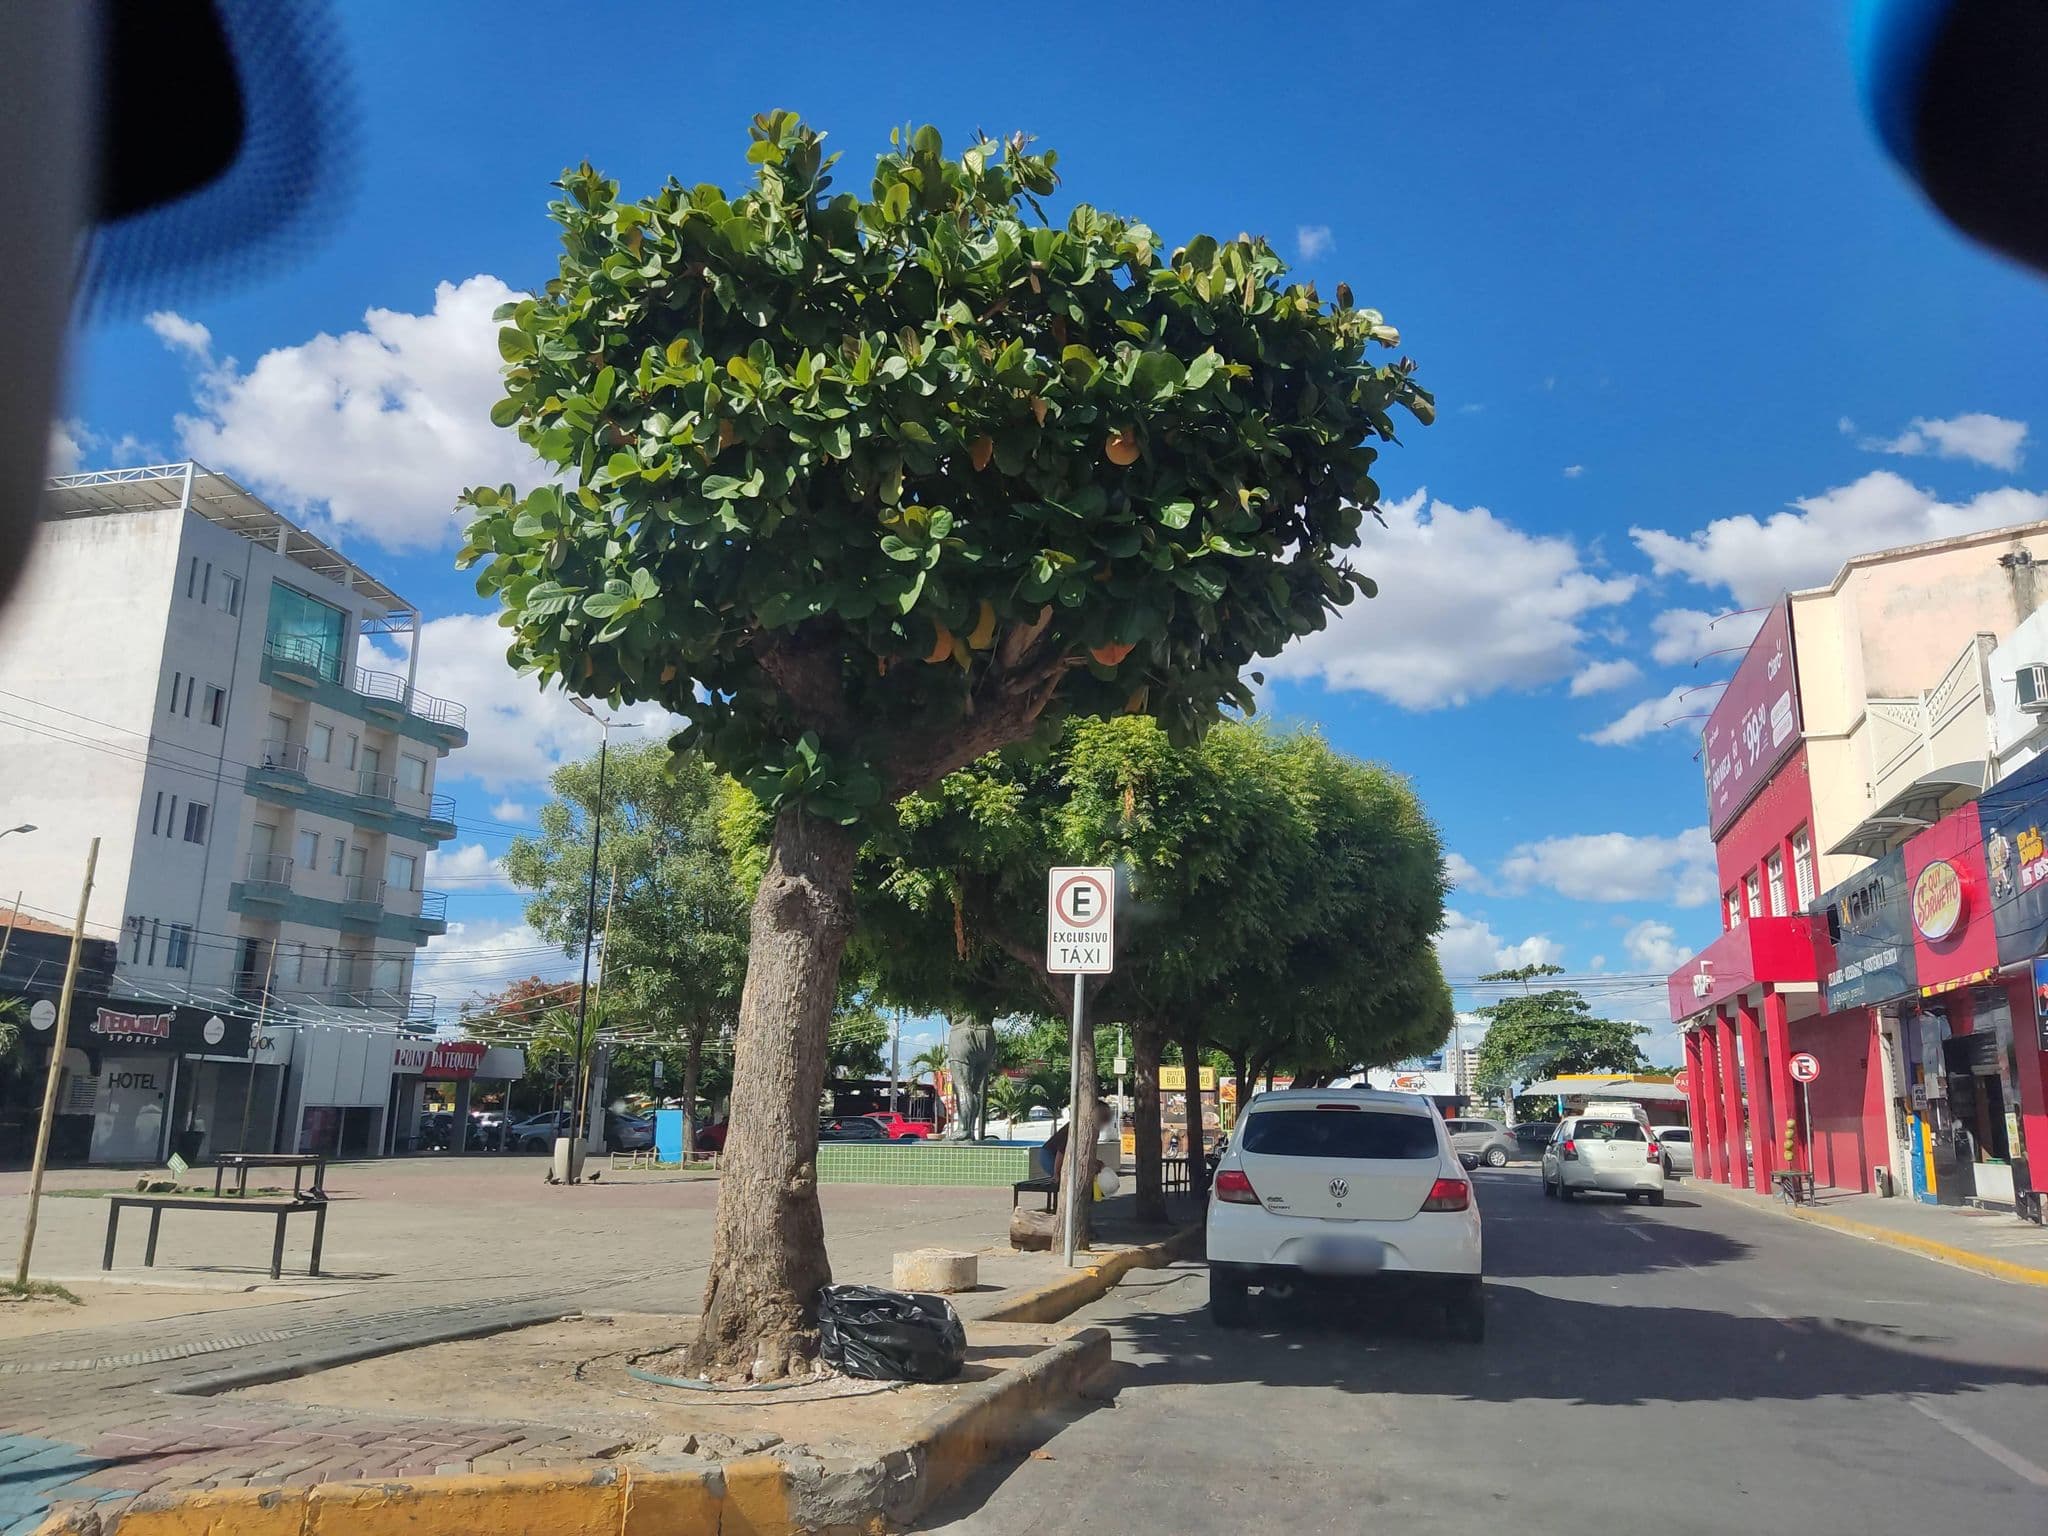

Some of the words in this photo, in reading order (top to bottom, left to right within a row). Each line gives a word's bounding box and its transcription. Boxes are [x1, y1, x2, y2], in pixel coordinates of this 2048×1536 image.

[1072, 887, 1091, 916] E
[1053, 932, 1108, 943] EXCLUSIVO
[1060, 945, 1100, 964] TÁXI
[97, 1008, 170, 1038] TEQUILA
[109, 1034, 158, 1045] SPORTS
[431, 1050, 443, 1068] DA
[445, 1051, 480, 1071] TEQUILA
[109, 1072, 158, 1089] HOTEL
